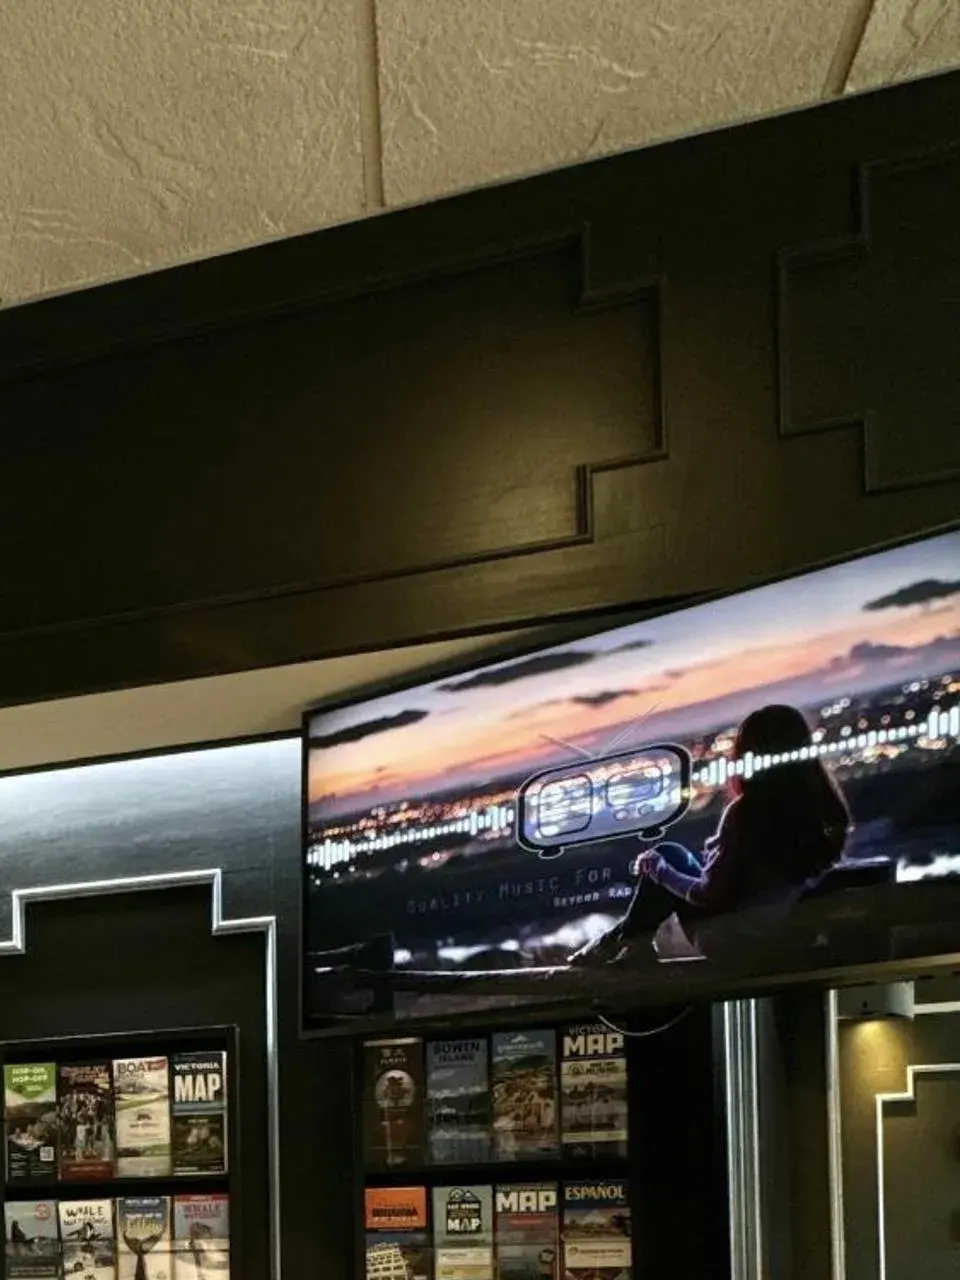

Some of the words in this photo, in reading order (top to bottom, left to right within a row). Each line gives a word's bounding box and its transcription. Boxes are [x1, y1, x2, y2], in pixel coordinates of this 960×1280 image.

[499, 876, 561, 901] MUSIC
[574, 866, 613, 886] FOR
[563, 1033, 624, 1057] MAP
[174, 1062, 220, 1071] VICTORIA
[174, 1074, 221, 1102] MAP
[496, 1190, 557, 1213] MAP
[565, 1183, 625, 1201] ESPAÑOL
[447, 1217, 482, 1231] MAP
